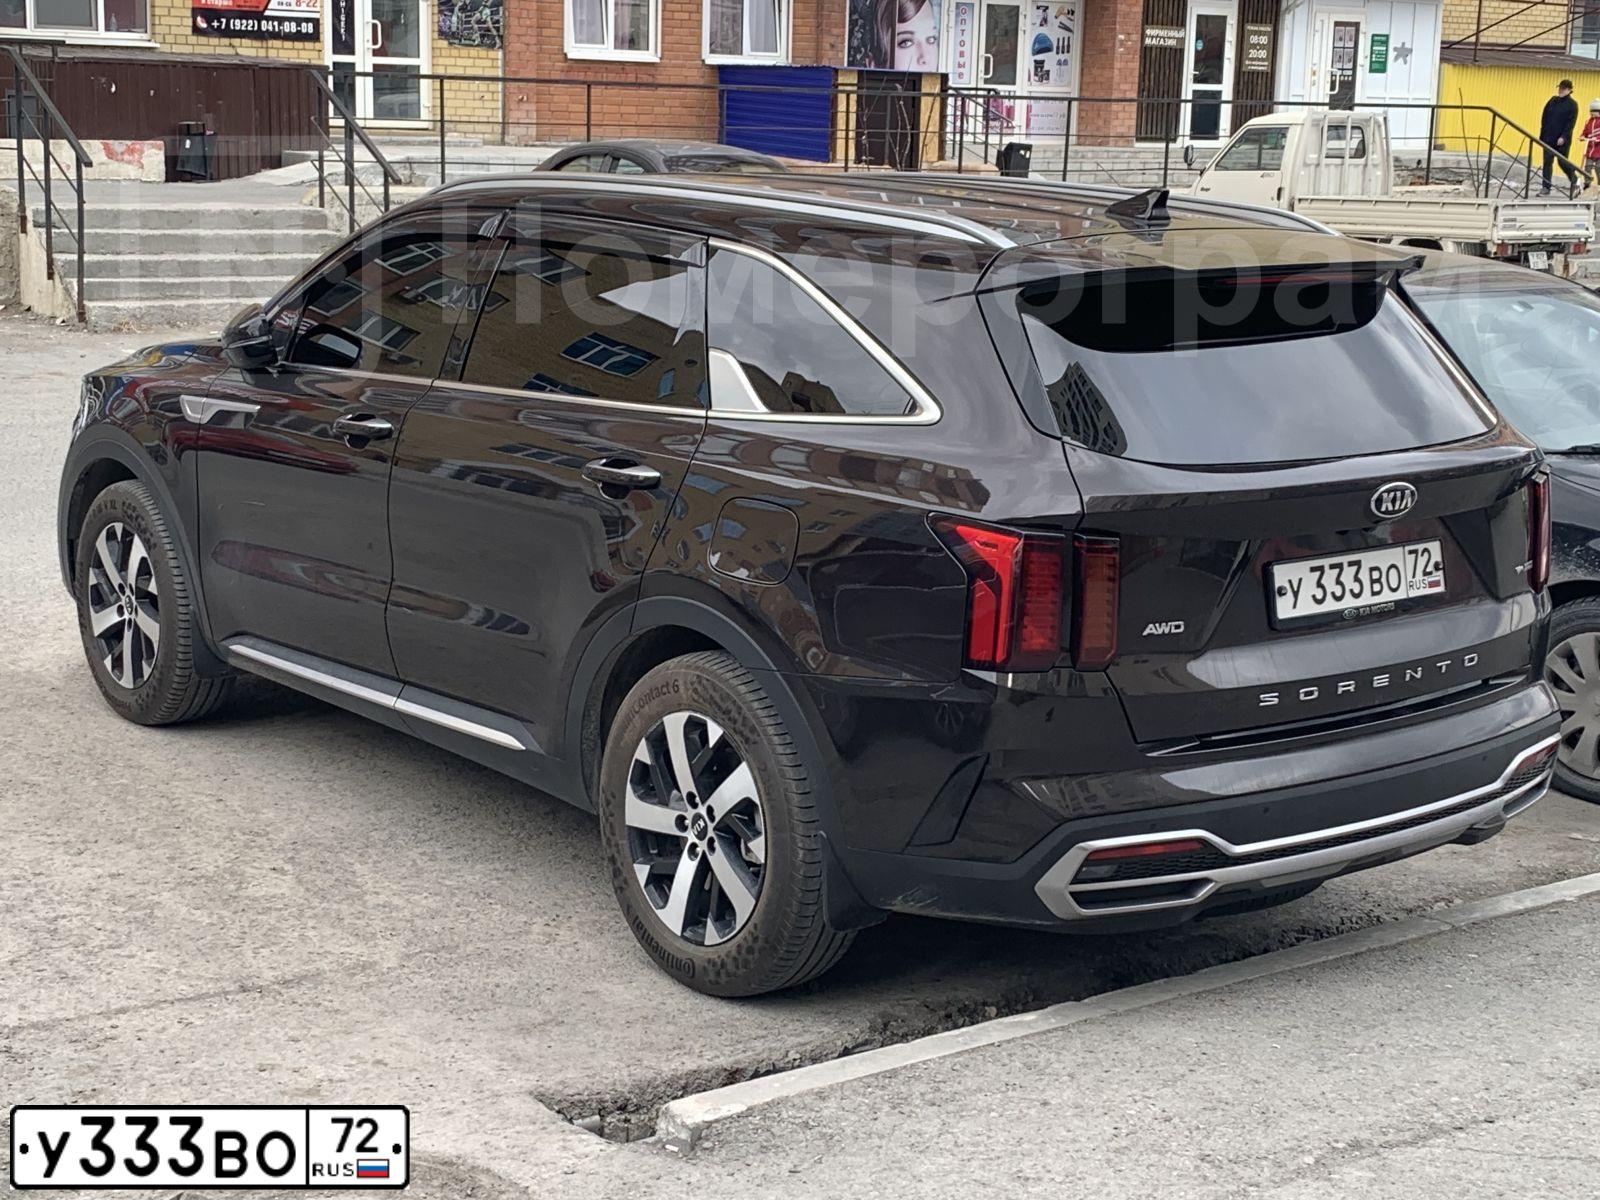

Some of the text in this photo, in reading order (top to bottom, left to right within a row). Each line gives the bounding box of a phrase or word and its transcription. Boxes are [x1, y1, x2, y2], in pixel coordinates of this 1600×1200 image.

[211, 19, 314, 34] +7 (922) 041-08-08
[1145, 28, 1186, 38] ФИРМЕННЫЙ
[1144, 37, 1177, 46] МАГАЗИН
[1249, 34, 1268, 45] 08:00
[1248, 49, 1267, 59] 20:00
[1380, 489, 1412, 512] KIA
[1407, 547, 1433, 579] 72
[1408, 579, 1428, 591] RUS
[1142, 620, 1185, 637] AWD
[1259, 652, 1480, 707] SORENTO
[691, 818, 706, 836] KIA
